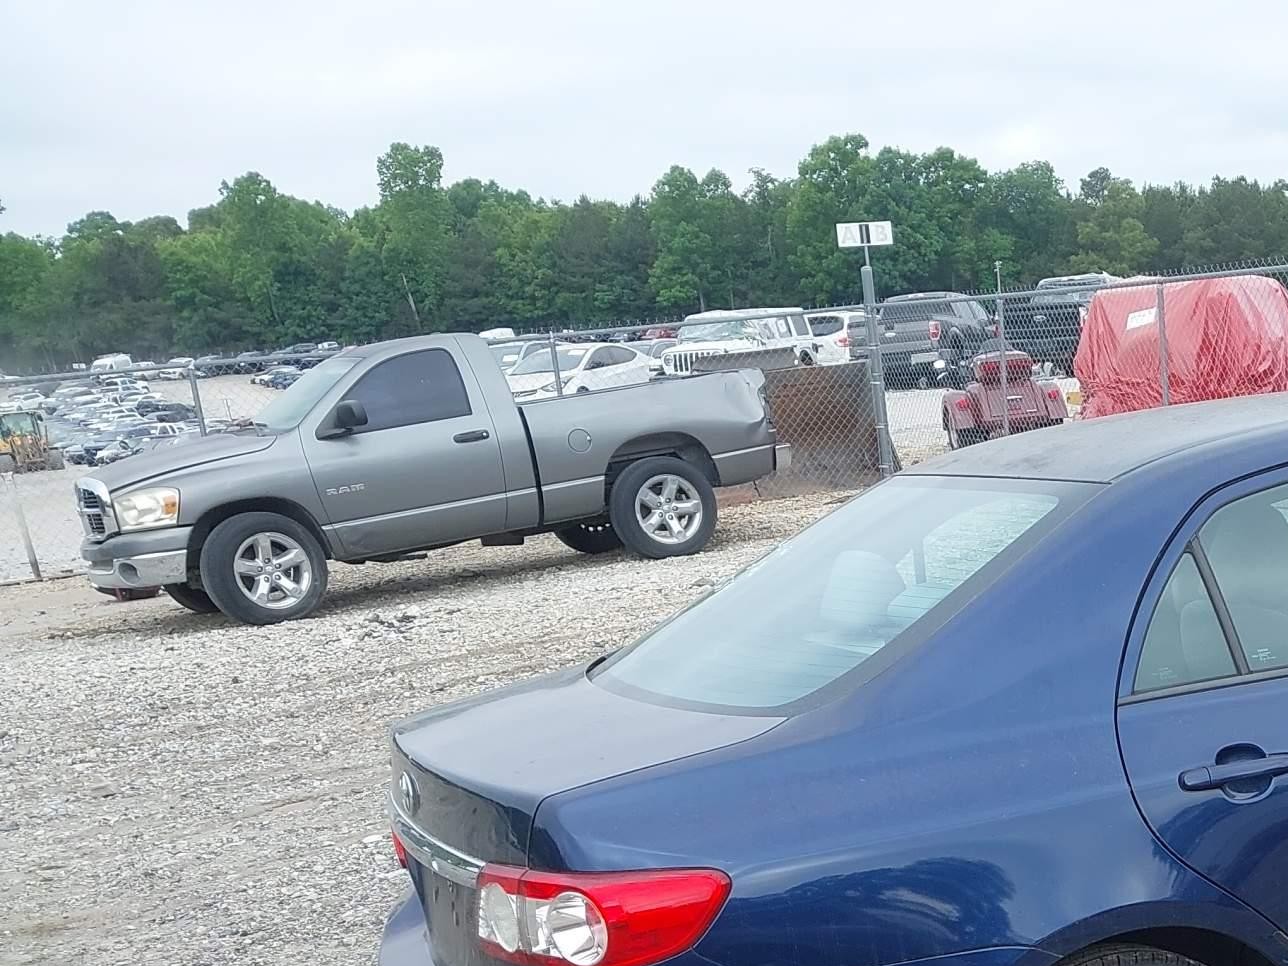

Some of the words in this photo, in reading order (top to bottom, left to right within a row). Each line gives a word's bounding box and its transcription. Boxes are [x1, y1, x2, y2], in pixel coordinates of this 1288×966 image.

[841, 225, 858, 244] A
[874, 224, 888, 242] B
[326, 483, 365, 496] RAM
